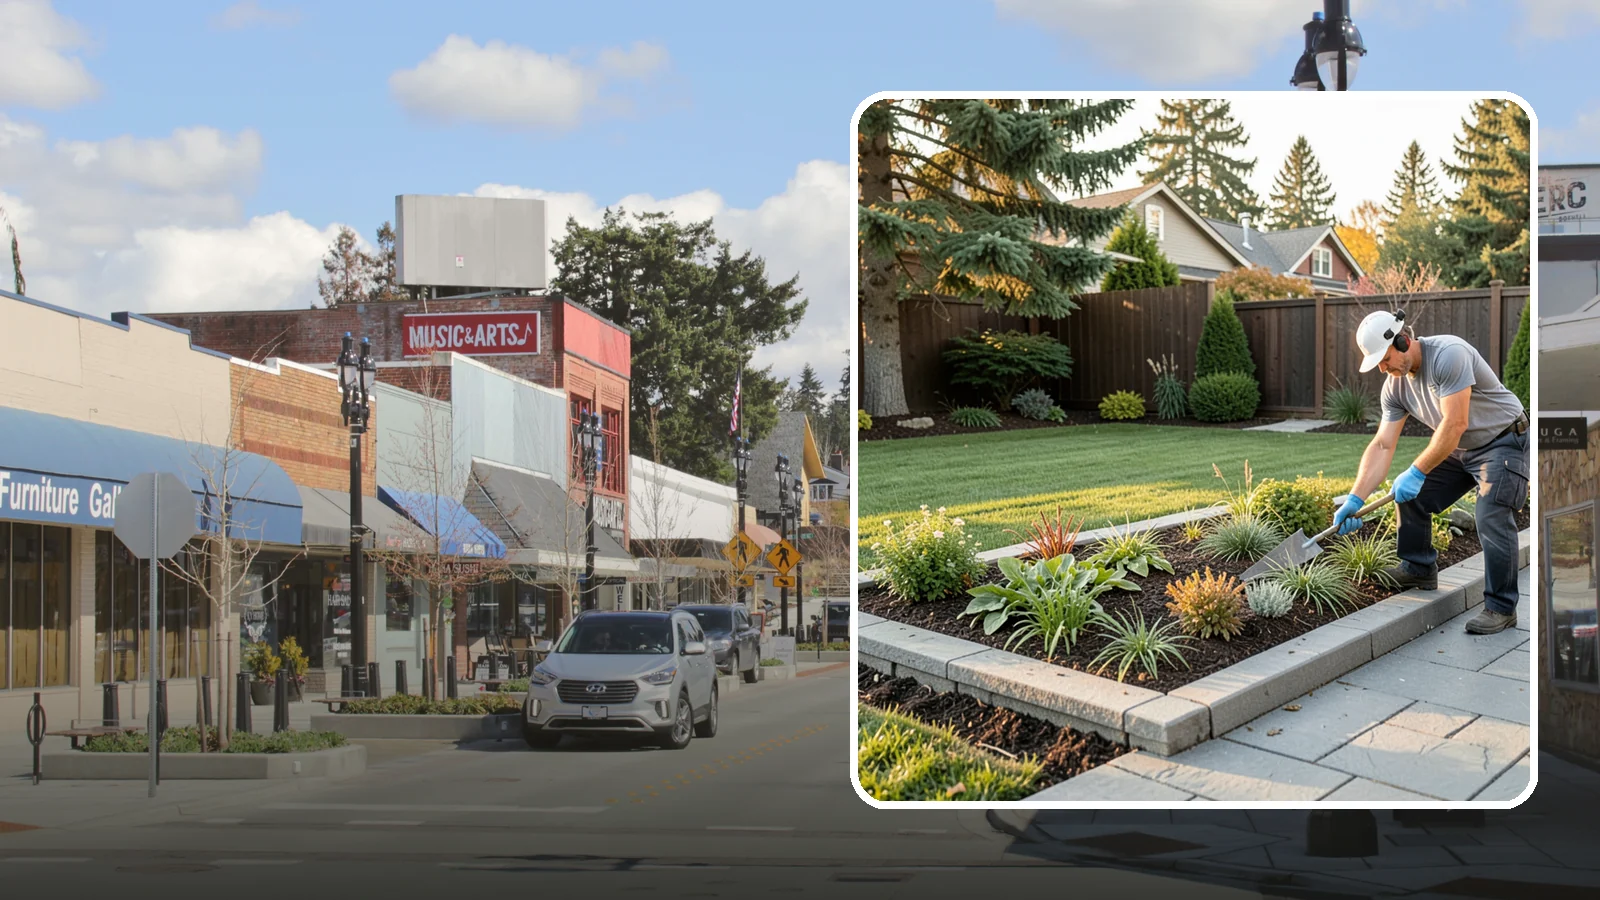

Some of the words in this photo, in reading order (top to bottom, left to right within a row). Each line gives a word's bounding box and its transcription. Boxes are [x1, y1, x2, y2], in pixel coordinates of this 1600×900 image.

[409, 323, 519, 348] MUSIC&ARTS
[1540, 427, 1577, 436] UGA
[0, 471, 79, 515] Furniture
[89, 482, 121, 519] Gal
